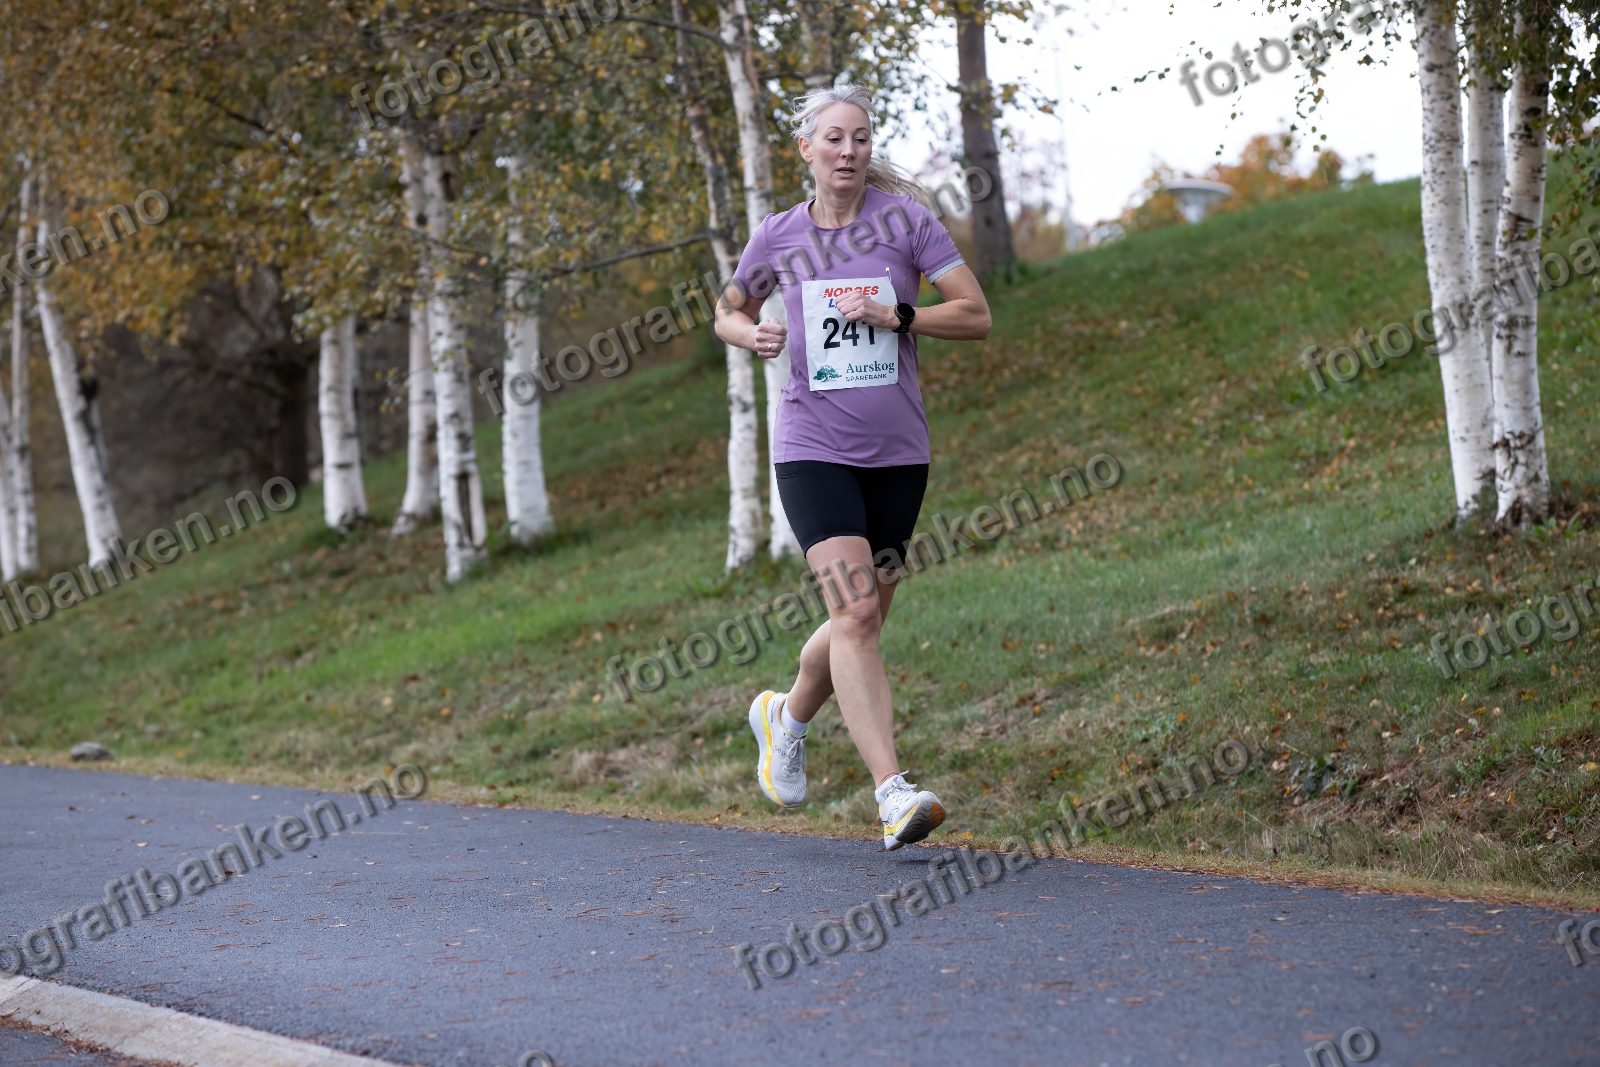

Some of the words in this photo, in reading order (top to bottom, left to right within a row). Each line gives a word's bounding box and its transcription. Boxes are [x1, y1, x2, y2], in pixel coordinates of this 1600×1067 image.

[822, 317, 875, 350] 241
[846, 360, 895, 374] Aurskog
[845, 373, 888, 382] SPAREBANK
